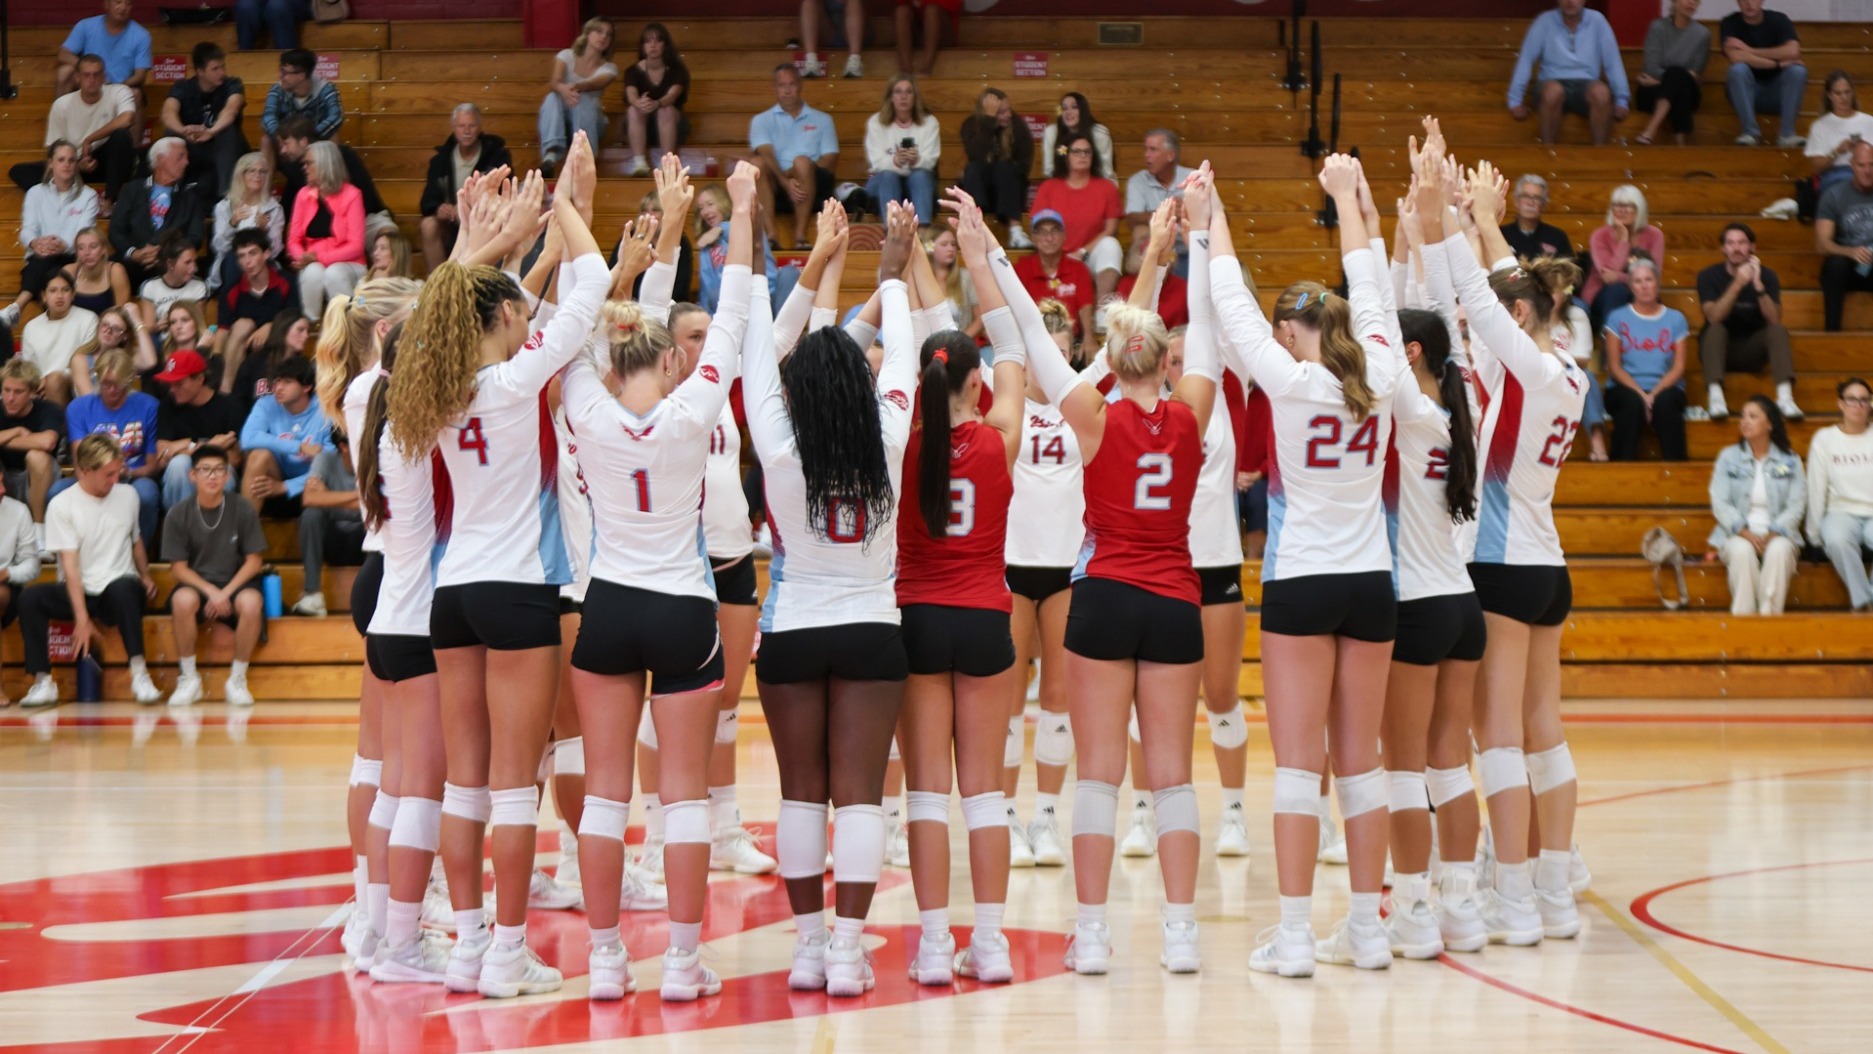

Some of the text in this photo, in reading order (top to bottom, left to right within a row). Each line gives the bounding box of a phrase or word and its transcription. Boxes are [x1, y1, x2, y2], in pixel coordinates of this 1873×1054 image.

[458, 416, 489, 466] 4
[710, 425, 726, 454] 11
[1030, 434, 1067, 465] 14
[1305, 413, 1379, 469] 24
[1832, 454, 1873, 465] BIOL
[630, 468, 652, 512] 1
[1134, 452, 1173, 510] 2
[826, 495, 867, 543] 0
[945, 477, 976, 537] 3
